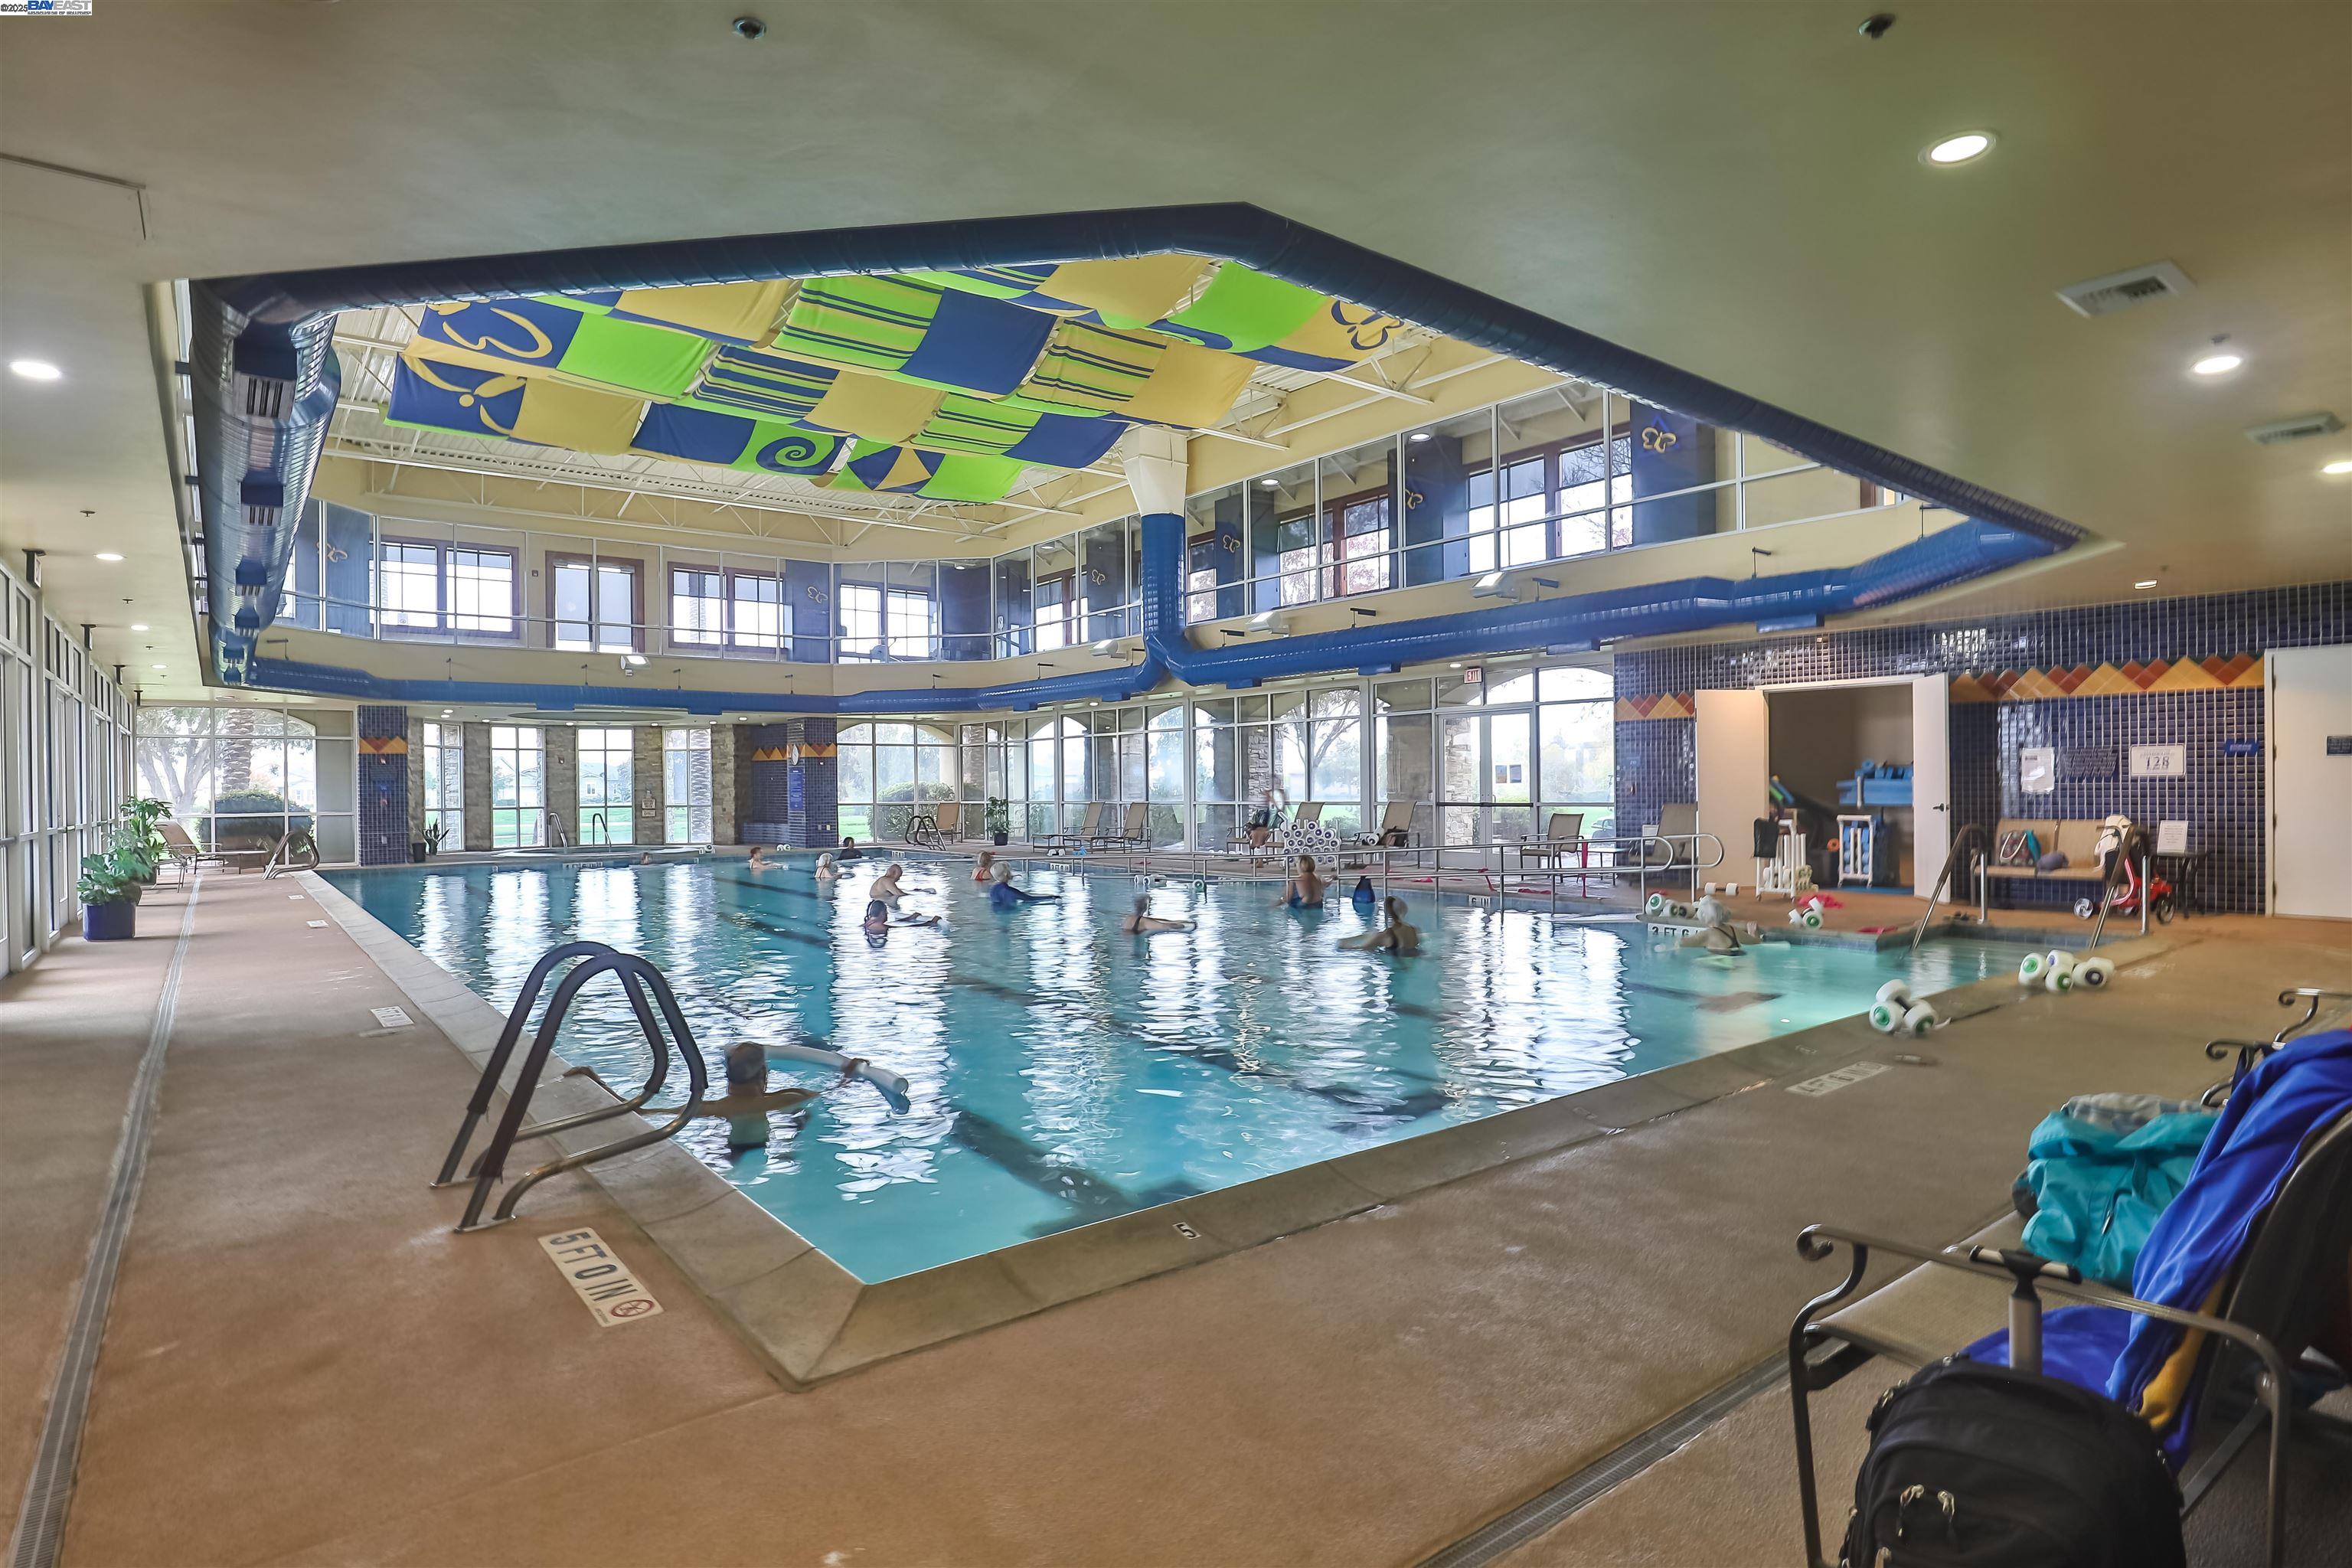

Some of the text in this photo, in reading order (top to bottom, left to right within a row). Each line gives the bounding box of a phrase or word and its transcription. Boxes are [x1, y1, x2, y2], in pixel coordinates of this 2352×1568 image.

[1467, 669, 1479, 681] EXIT
[2146, 756, 2170, 770] 128
[1664, 927, 1677, 936] FT
[1176, 1223, 1196, 1237] 5
[550, 1232, 591, 1245] 5
[557, 1244, 608, 1263] FT
[583, 1279, 639, 1302] IN
